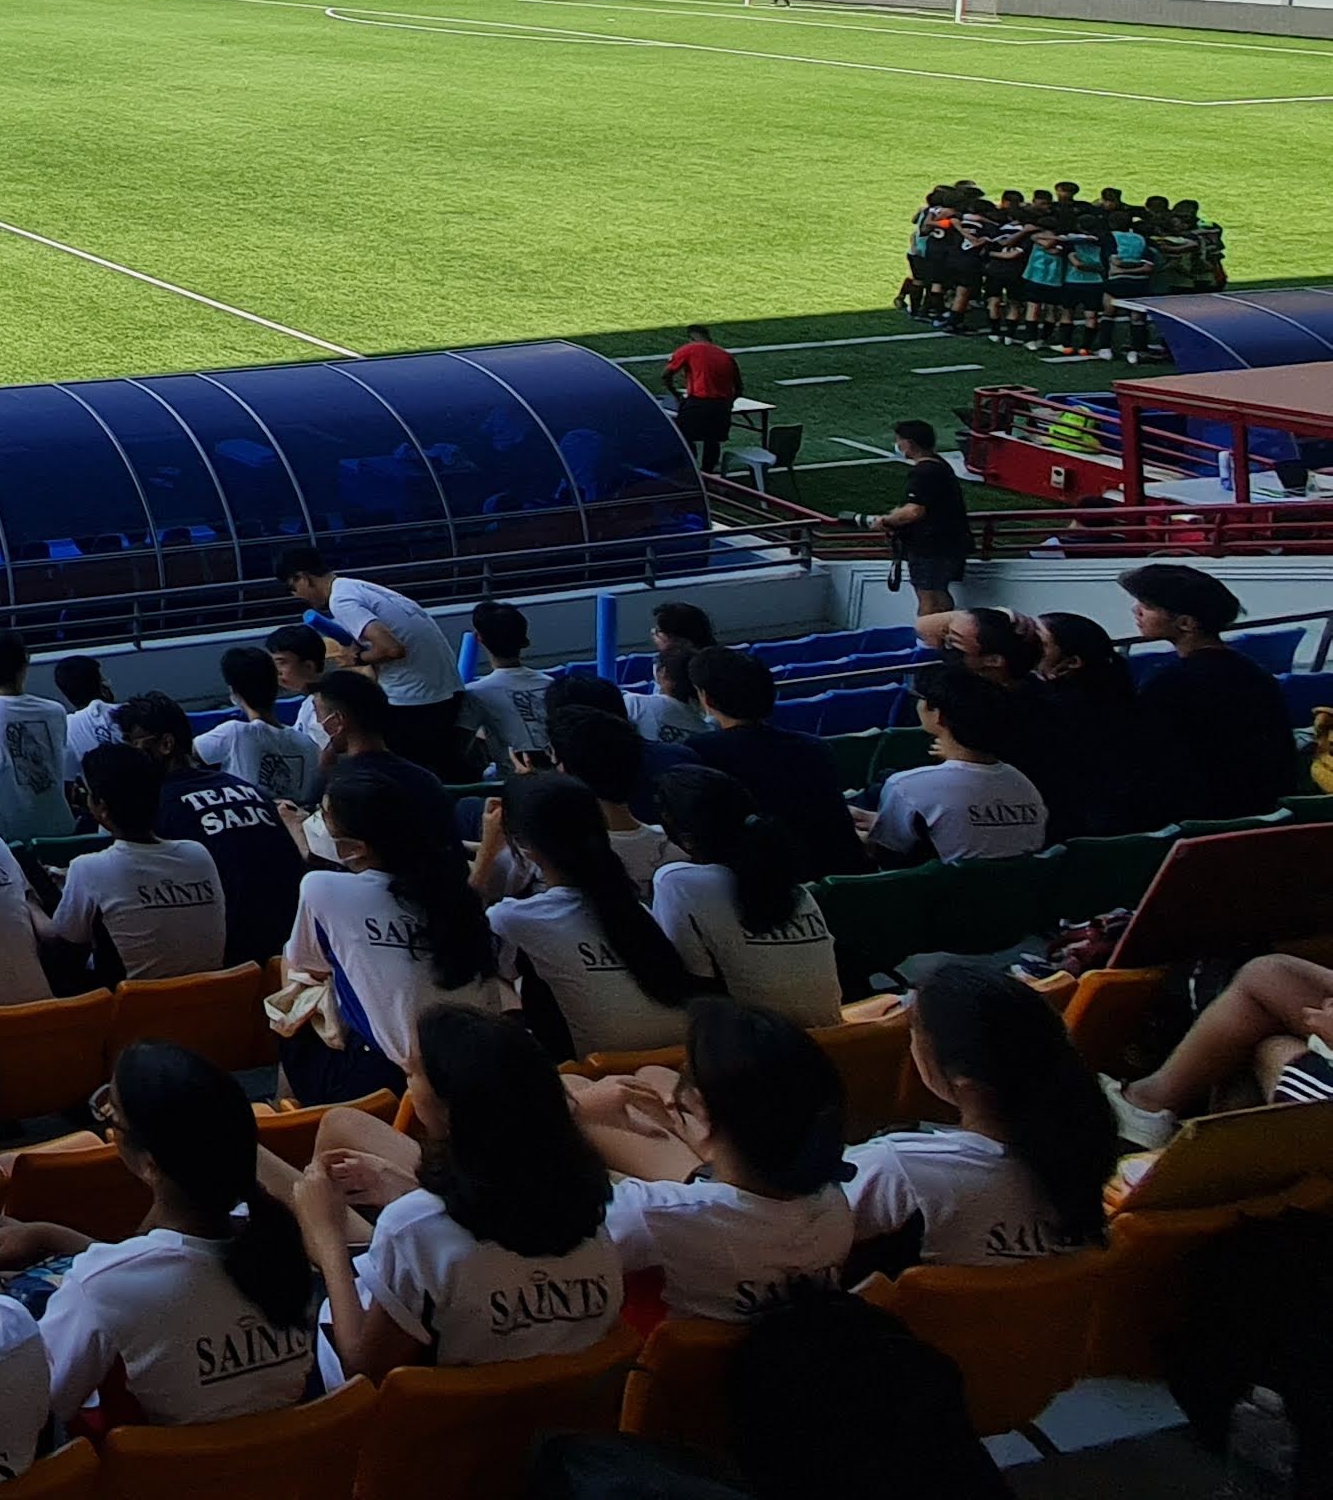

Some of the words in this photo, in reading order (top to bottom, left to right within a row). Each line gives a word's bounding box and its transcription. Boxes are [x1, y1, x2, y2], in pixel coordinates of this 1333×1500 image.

[181, 785, 265, 812] TEAM
[199, 802, 278, 836] SAJC
[139, 880, 214, 904] SAINTS
[490, 1275, 608, 1326] SAINTS
